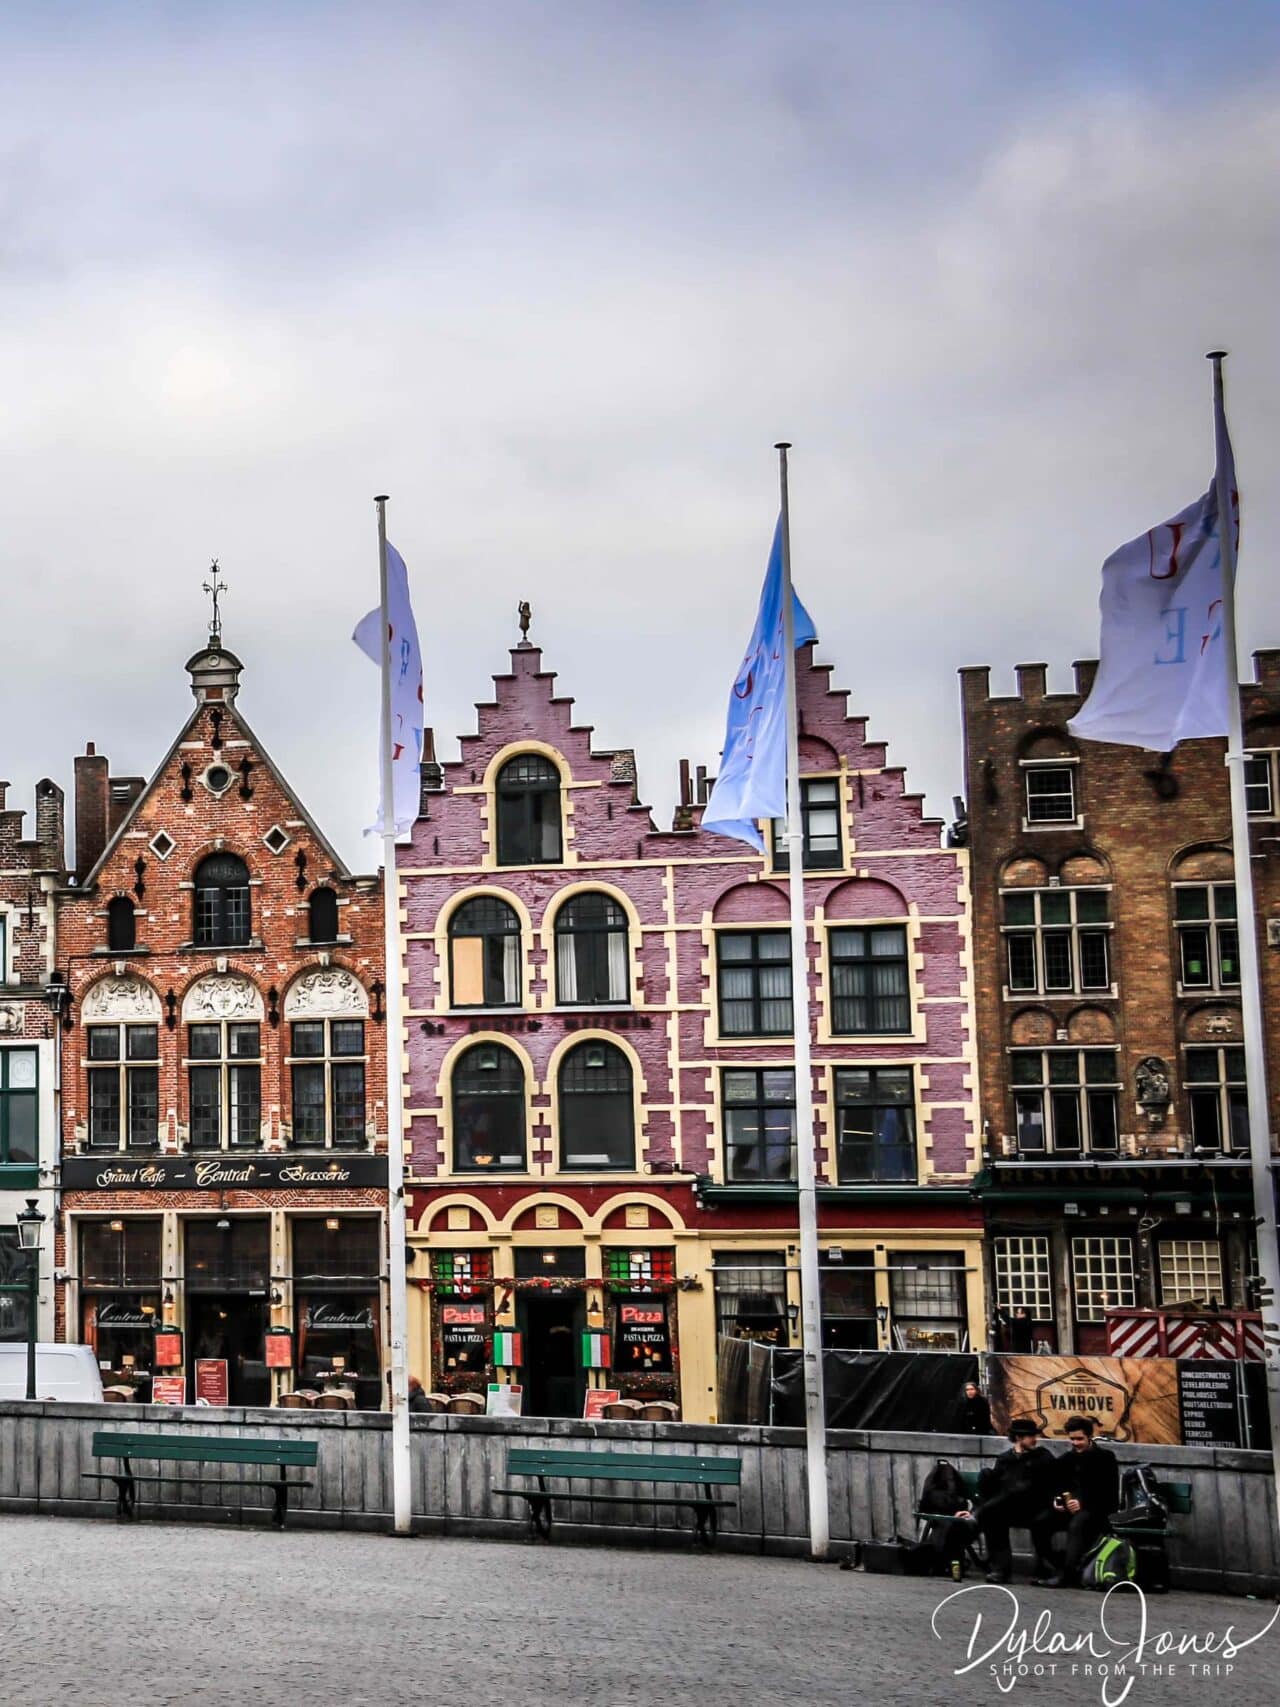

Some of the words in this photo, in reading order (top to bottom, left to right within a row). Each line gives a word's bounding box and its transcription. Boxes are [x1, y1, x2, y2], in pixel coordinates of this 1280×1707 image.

[96, 1167, 138, 1187] Grand
[194, 1161, 255, 1187] Central
[279, 1166, 350, 1182] Brasserie
[1000, 1167, 1163, 1183] RESTAURANT
[99, 1303, 147, 1321] Central
[312, 1303, 366, 1322] Central
[443, 1307, 485, 1323] Pasta
[621, 1306, 664, 1323] Pizza
[444, 1334, 462, 1343] PASTA
[467, 1334, 485, 1343] PIZZA
[623, 1333, 642, 1342] PASTA
[647, 1333, 665, 1342] PIZZA
[1049, 1394, 1114, 1412] VANHOVE
